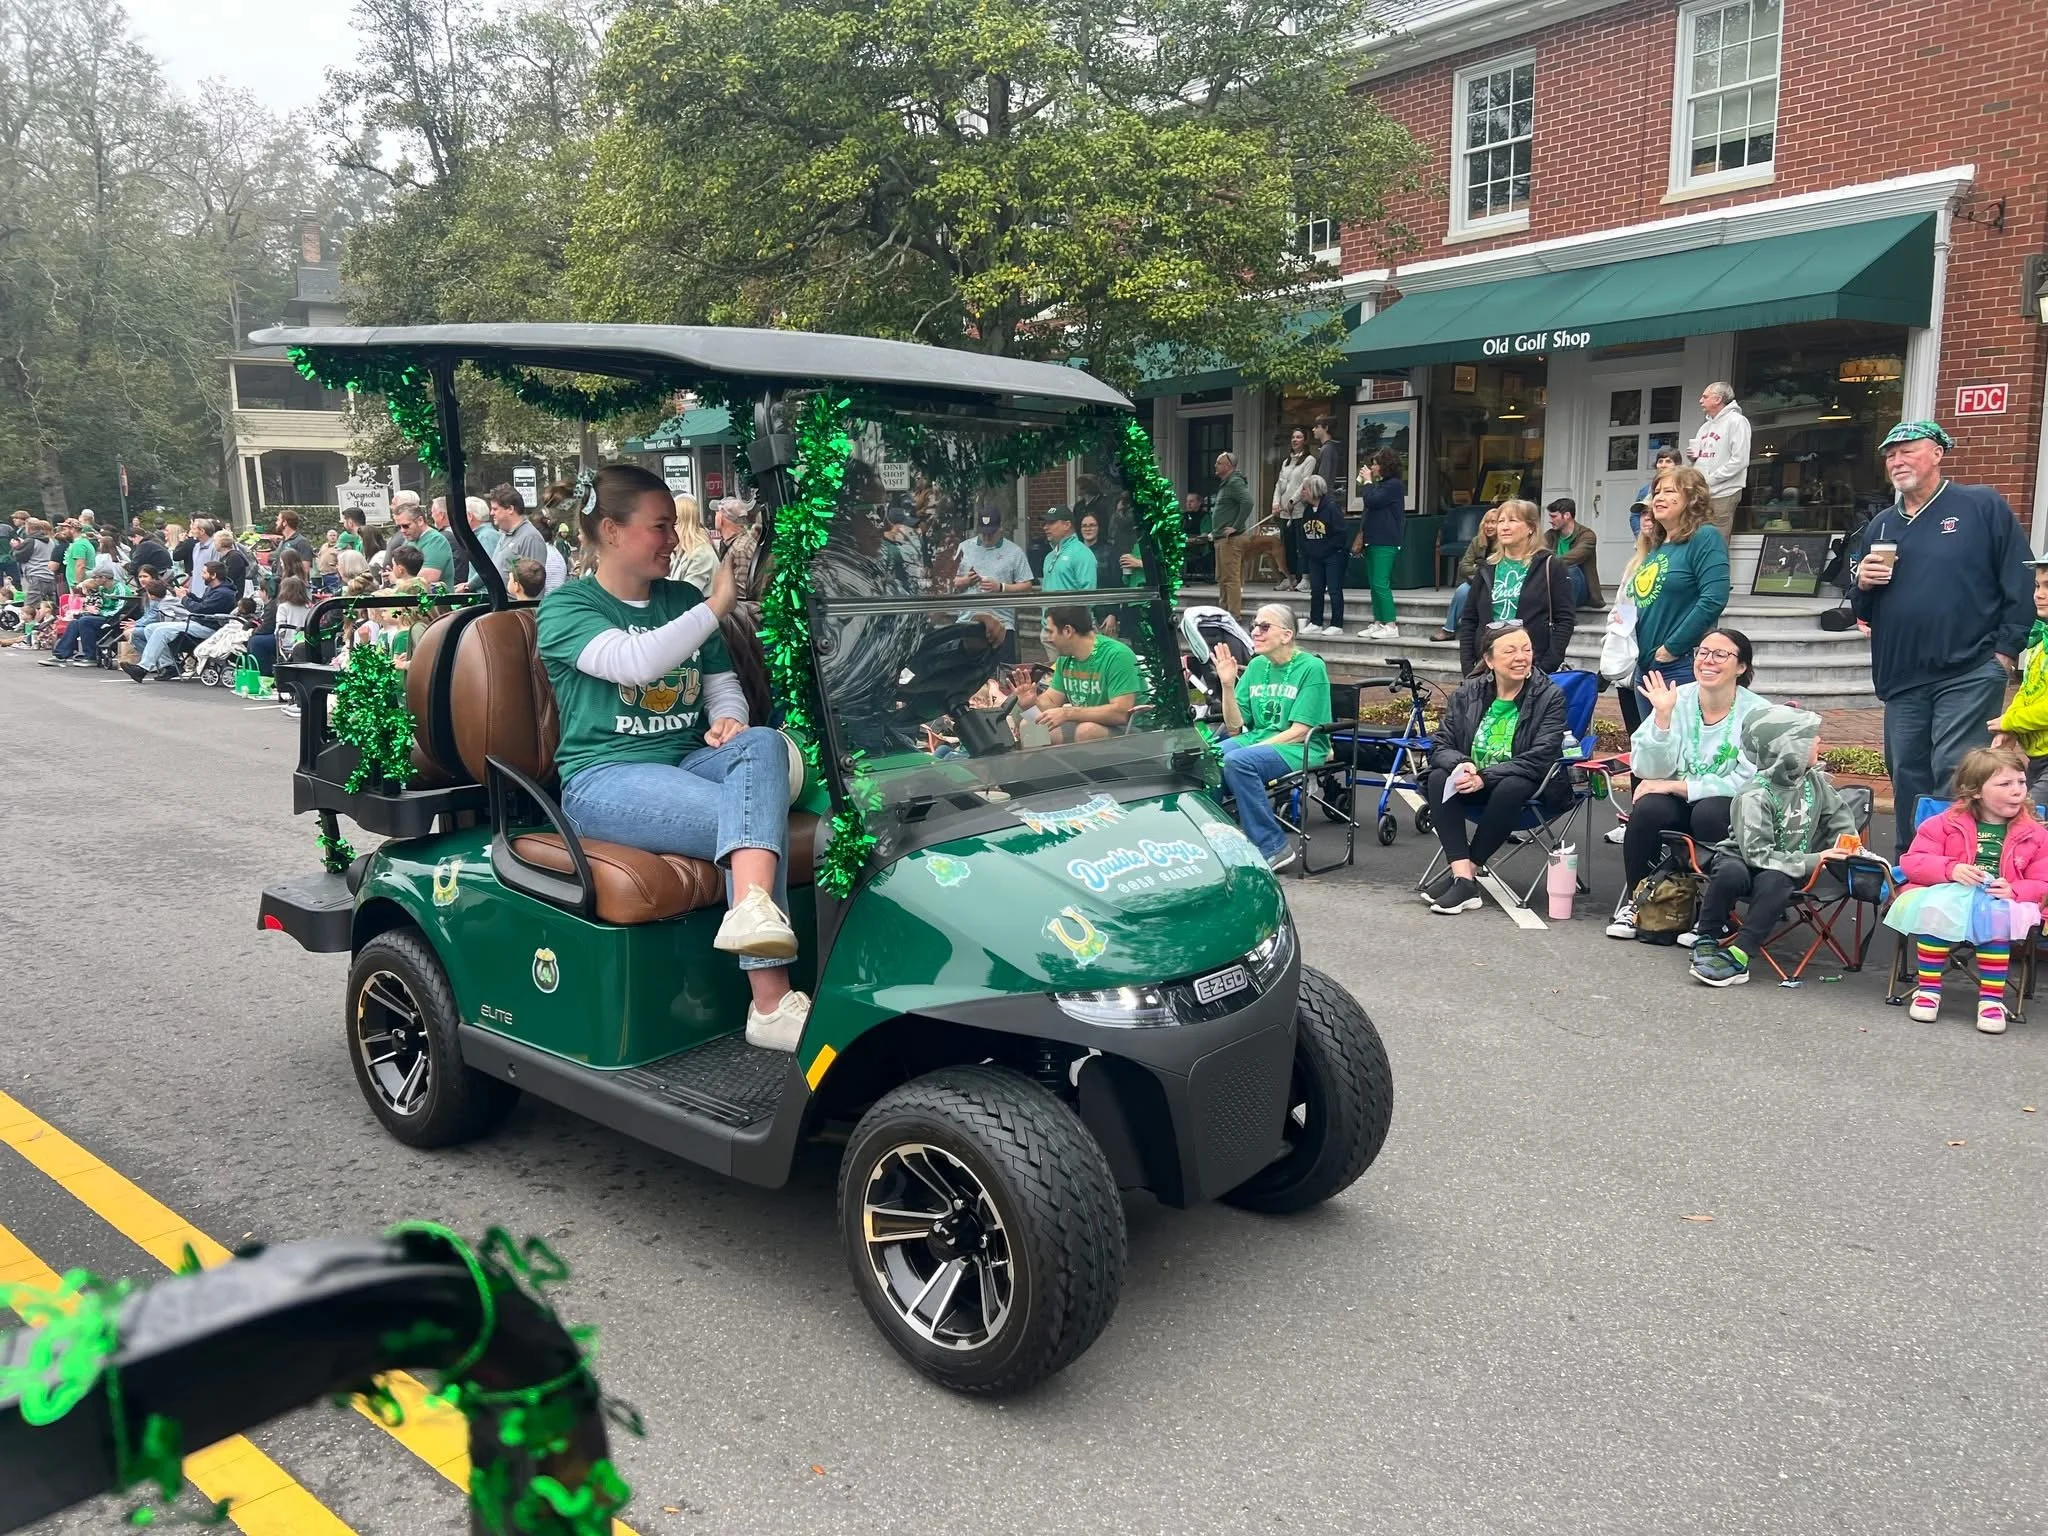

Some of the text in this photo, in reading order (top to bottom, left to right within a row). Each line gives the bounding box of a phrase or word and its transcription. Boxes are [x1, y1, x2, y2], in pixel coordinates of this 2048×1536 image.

[1482, 330, 1590, 355] Old Golf Shop
[1960, 388, 2003, 411] FDC
[1067, 848, 1149, 892] Double
[1138, 839, 1208, 867] Eagle
[1117, 864, 1203, 893] GOLF CARTS
[481, 1004, 513, 1025] ELITE
